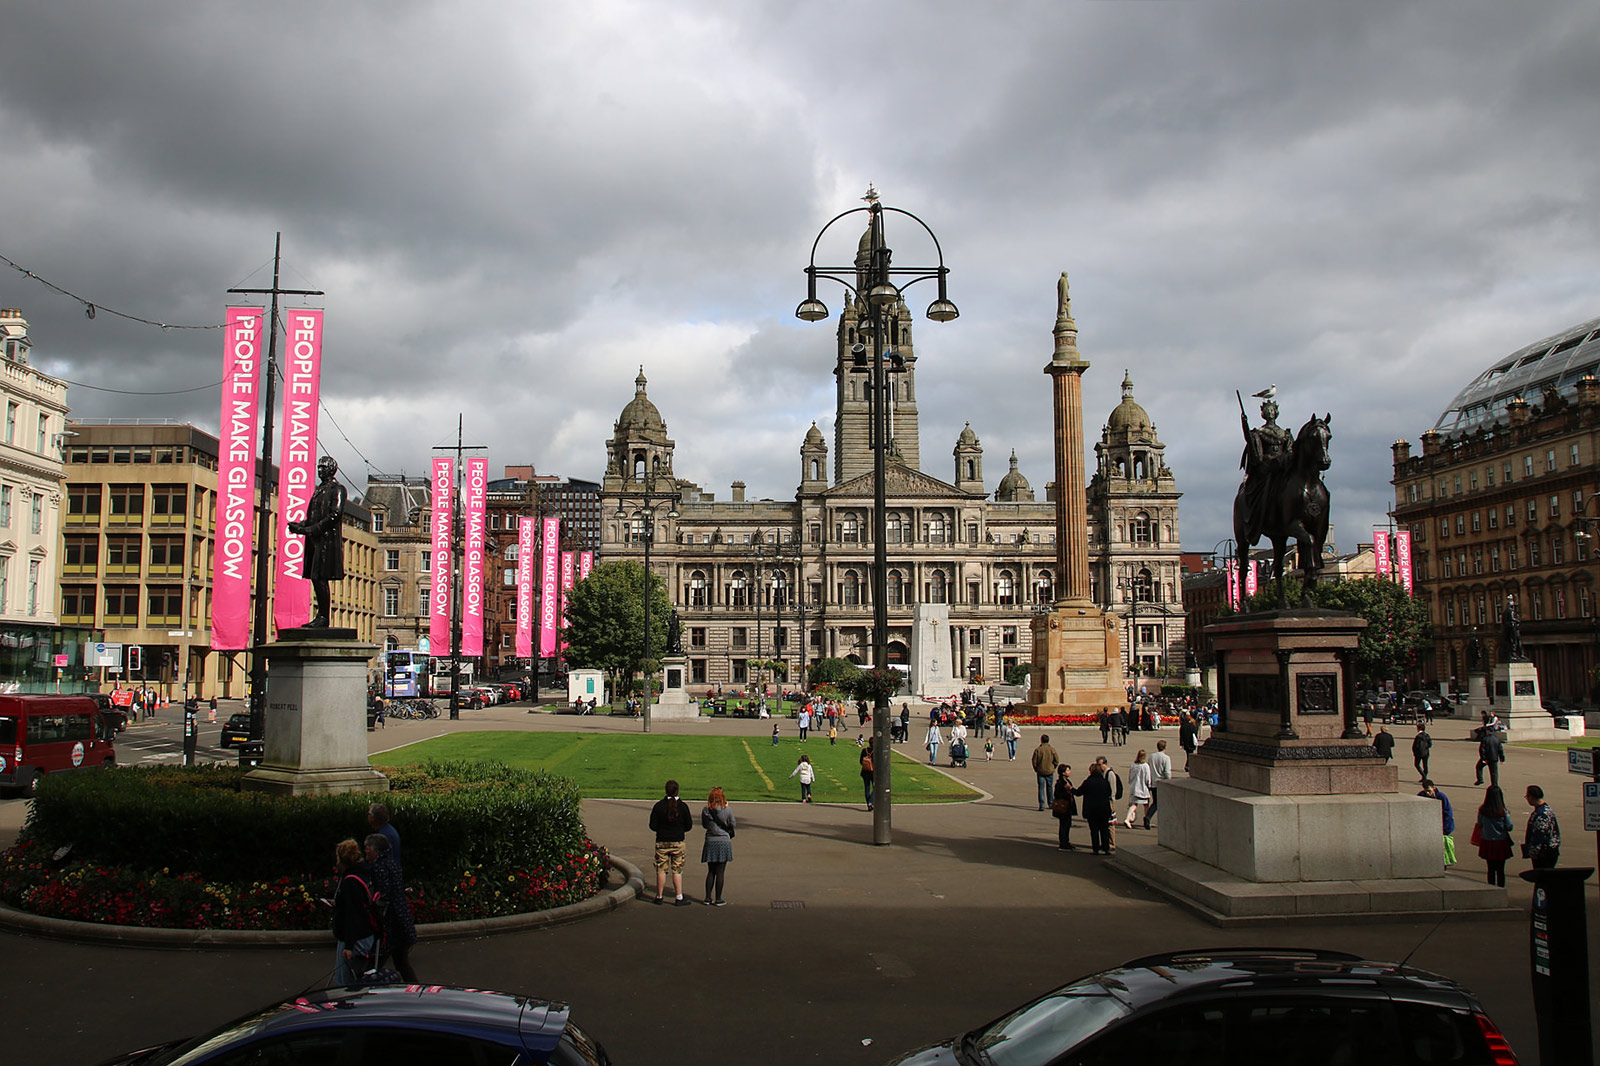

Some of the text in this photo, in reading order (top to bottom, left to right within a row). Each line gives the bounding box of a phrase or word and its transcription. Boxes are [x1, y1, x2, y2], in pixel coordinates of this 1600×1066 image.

[292, 316, 315, 394] PEOPLE
[223, 316, 255, 579] PEOPLE MAKE GLASGOW
[289, 401, 311, 462] MAKE
[436, 462, 449, 616] PEOPLE MAKE GLASGOW
[468, 462, 483, 616] PEOPLE MAKE GLASGOW
[520, 520, 531, 630] PEOPLE MAKE GLASGOW
[545, 520, 556, 630] PEOPLE MAKE GLASGOW
[564, 554, 572, 581] PEOPLE
[1377, 534, 1387, 566] PEOPLE
[1399, 534, 1410, 591] PEOPLE MAK
[1588, 785, 1596, 797] P
